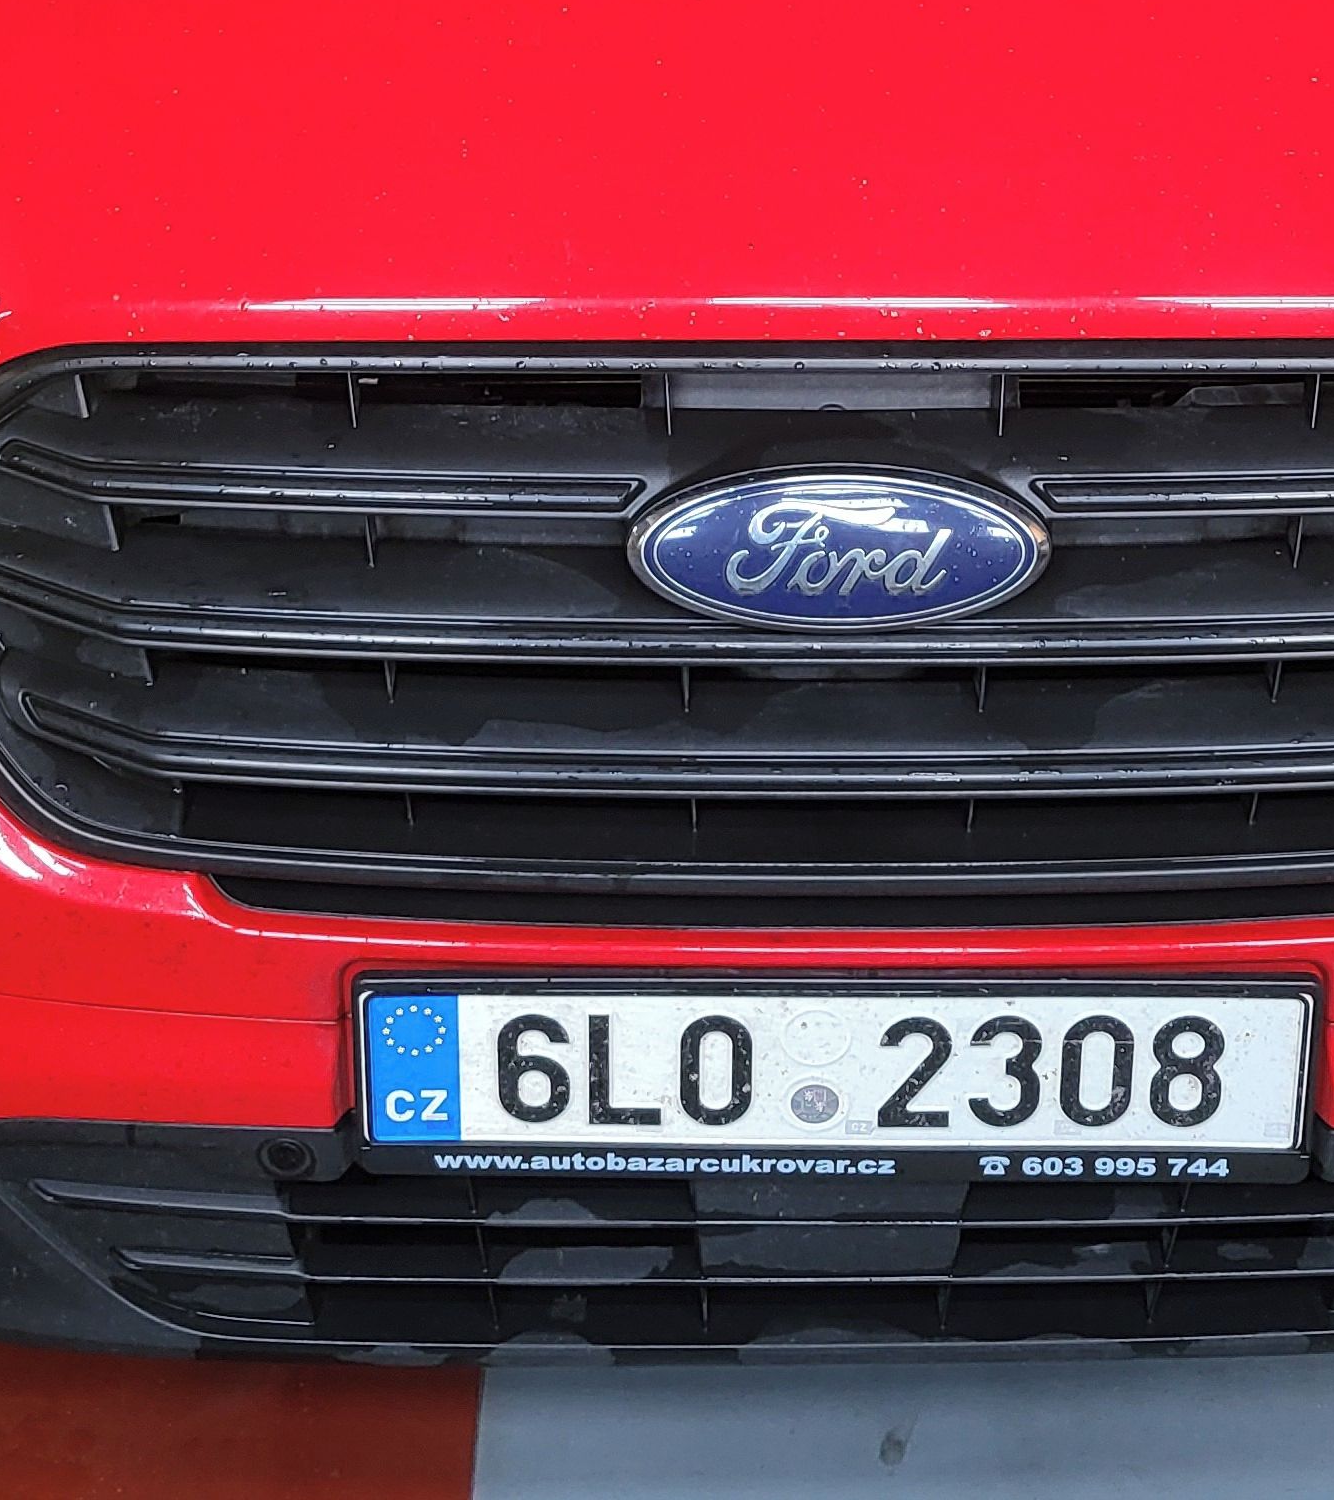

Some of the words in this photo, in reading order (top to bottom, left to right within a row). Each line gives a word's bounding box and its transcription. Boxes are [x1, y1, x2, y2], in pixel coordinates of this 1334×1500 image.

[725, 501, 952, 597] Ford
[497, 1013, 754, 1125] 6L0
[877, 1013, 1226, 1128] 2308
[385, 1088, 449, 1122] CZ
[434, 1151, 896, 1176] www.autobazarcukrovar.cz
[1021, 1156, 1085, 1177] 603
[1094, 1157, 1157, 1177] 995
[1167, 1157, 1230, 1178] 744
